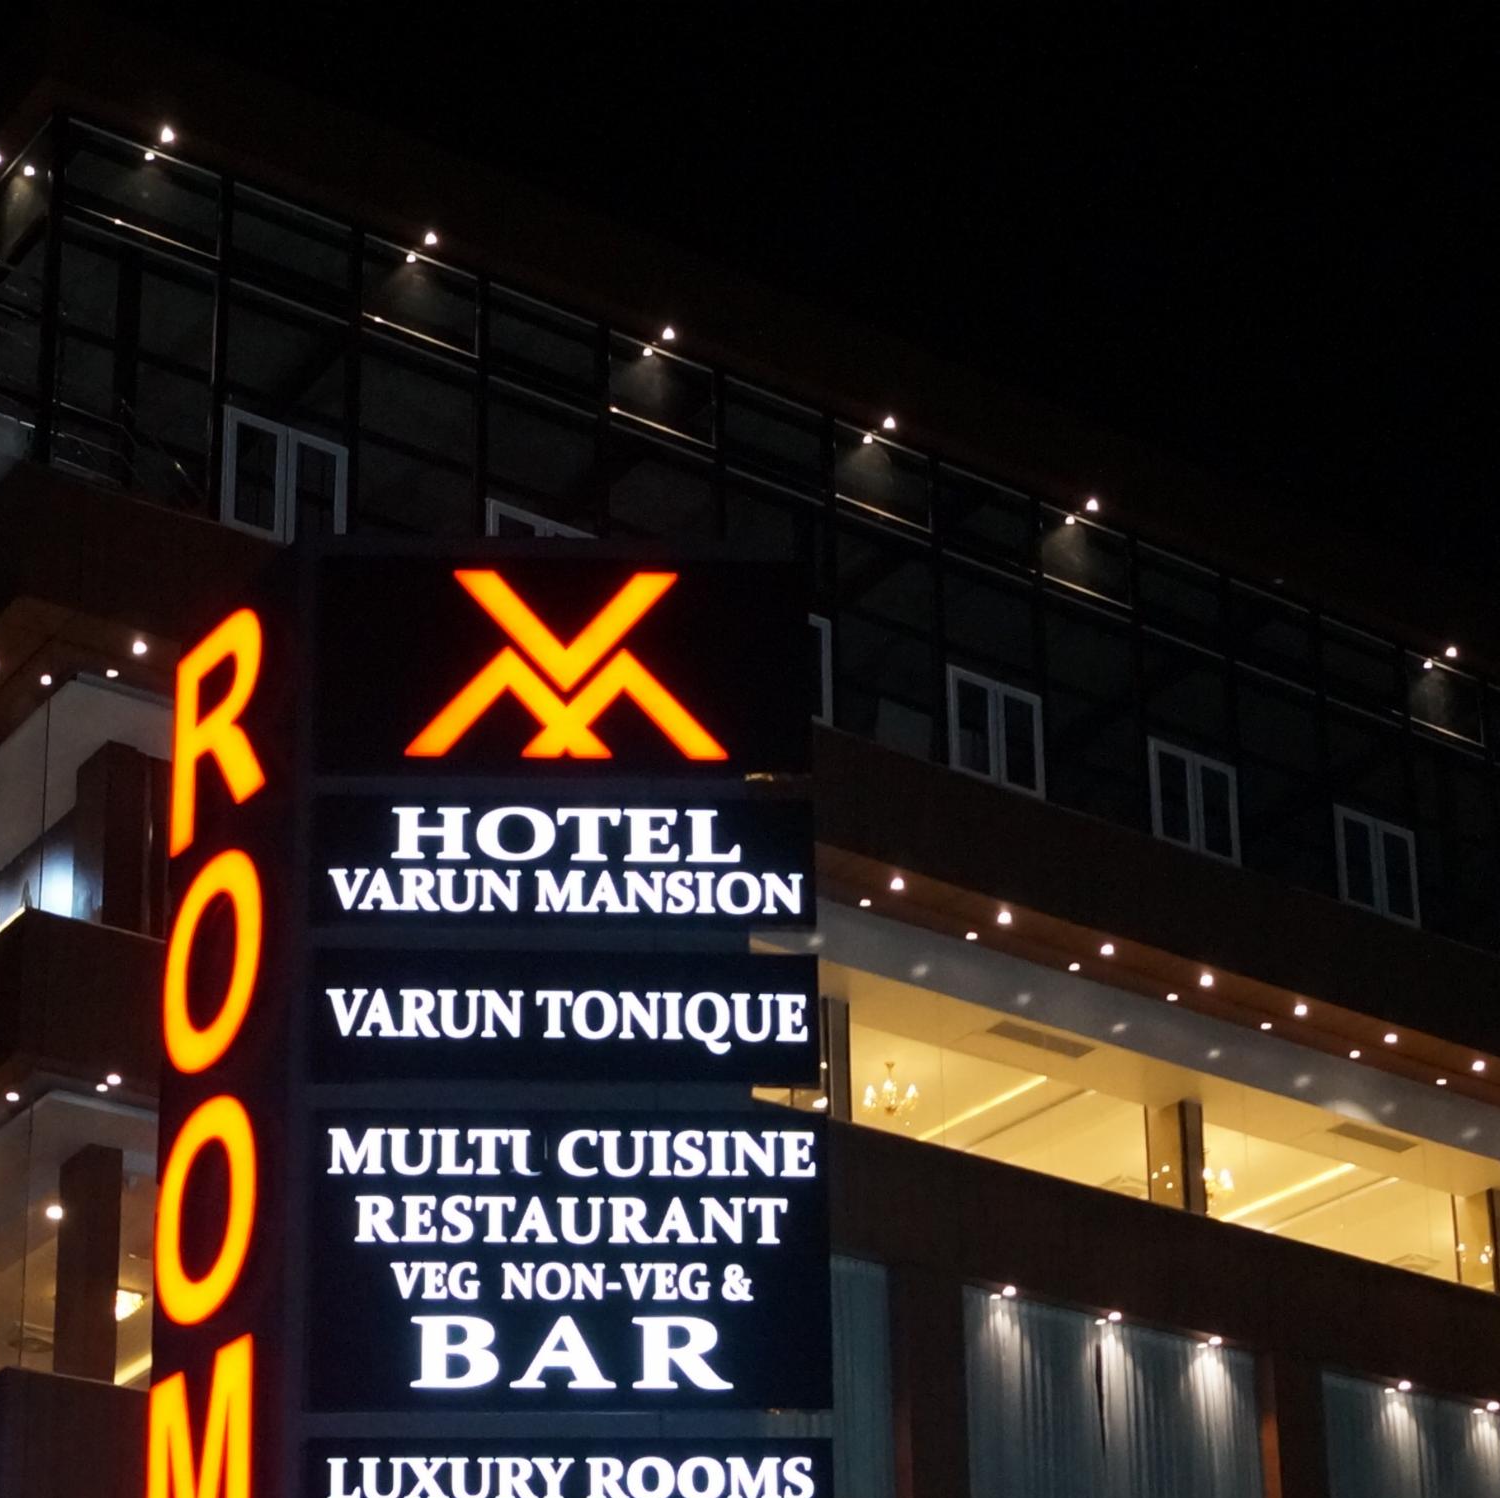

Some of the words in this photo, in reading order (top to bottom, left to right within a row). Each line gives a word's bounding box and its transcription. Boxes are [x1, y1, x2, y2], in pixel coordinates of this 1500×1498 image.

[391, 806, 741, 863] HOTEL
[328, 867, 521, 913] VARUN
[534, 869, 803, 915] MANSION
[325, 988, 523, 1039] VARUN
[535, 990, 808, 1055] TONIQUE
[557, 1129, 816, 1178] CUISINE
[354, 1194, 789, 1245] RESTAURANT
[390, 1261, 480, 1302] VEG
[502, 1262, 710, 1302] NON-VEG
[723, 1263, 754, 1302] &
[410, 1315, 734, 1391] BAR
